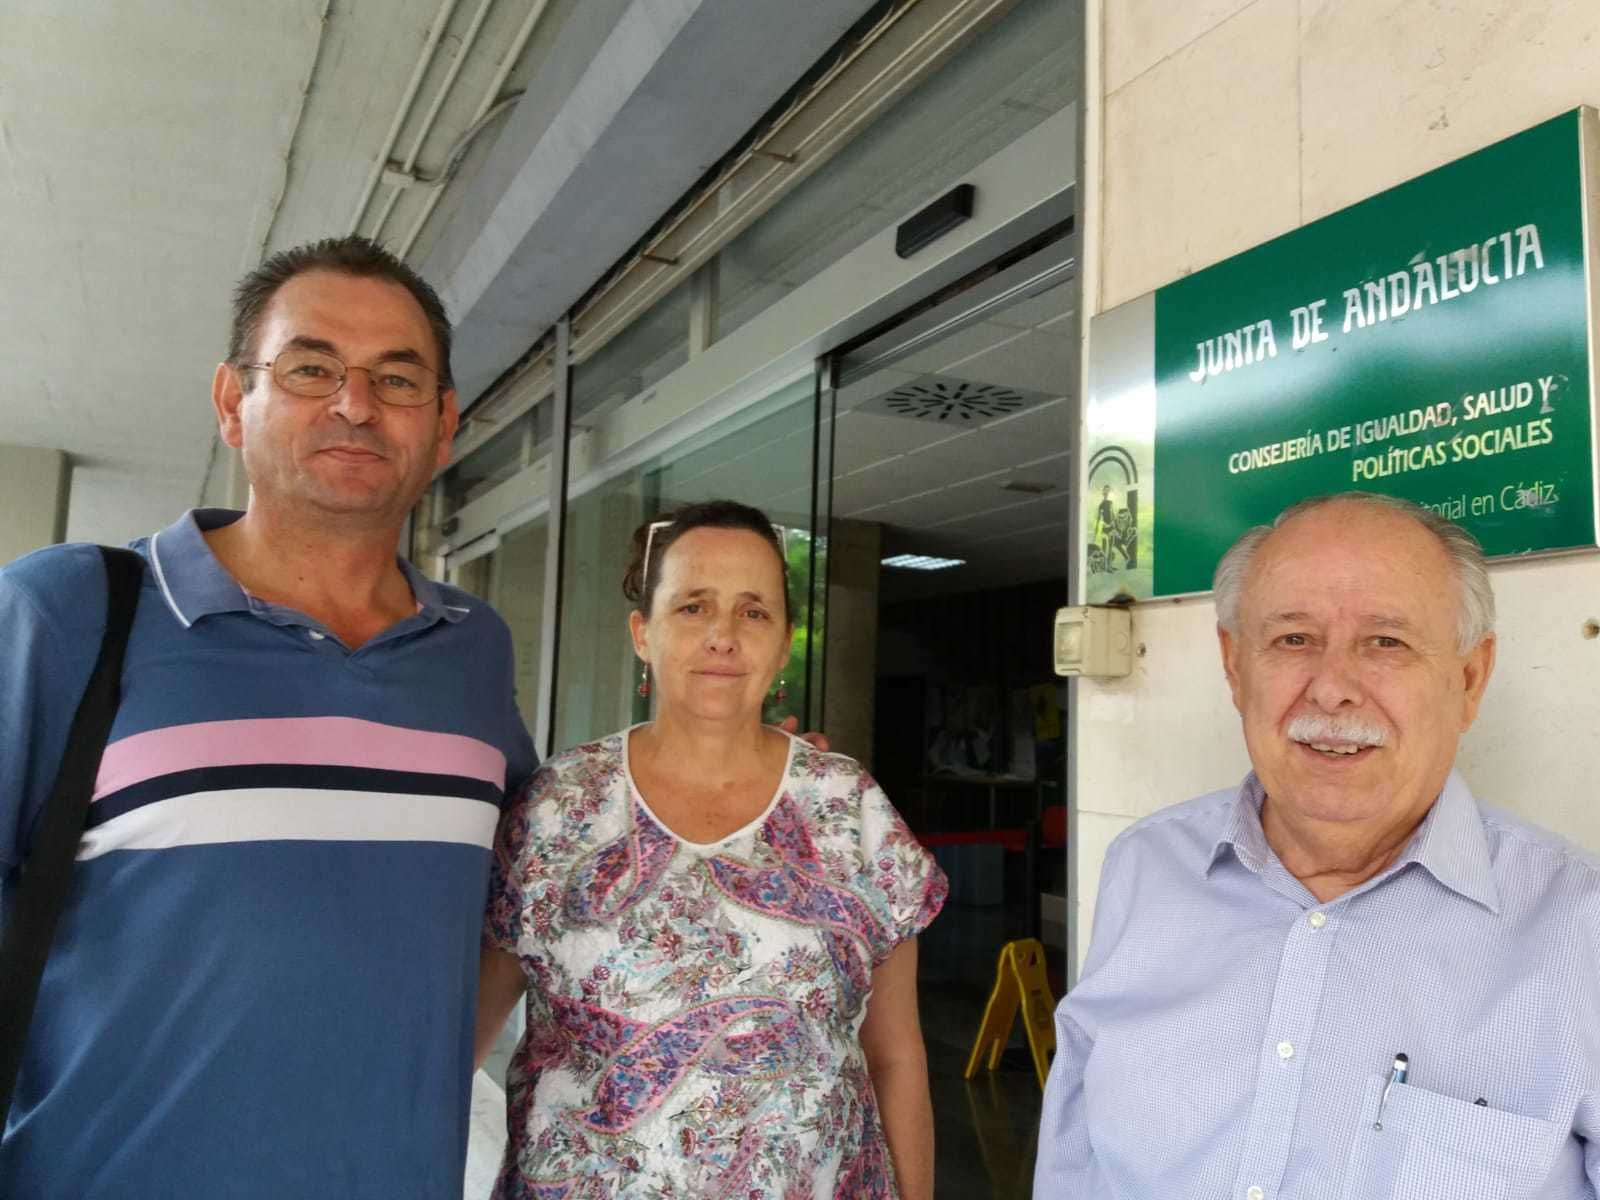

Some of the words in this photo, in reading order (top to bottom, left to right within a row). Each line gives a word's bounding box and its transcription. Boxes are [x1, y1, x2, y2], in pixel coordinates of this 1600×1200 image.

[1189, 319, 1278, 382] JUNTA
[1290, 299, 1329, 350] DE
[1228, 429, 1323, 474] CONSEJERÍA
[1327, 426, 1352, 452] DE
[1355, 402, 1458, 446] IGUALDAD,
[1463, 382, 1533, 420] SALUD
[1538, 375, 1554, 403] Y
[1352, 441, 1447, 482] POLÍTICAS
[1452, 418, 1553, 462] SOCIALES
[1471, 494, 1495, 516] en
